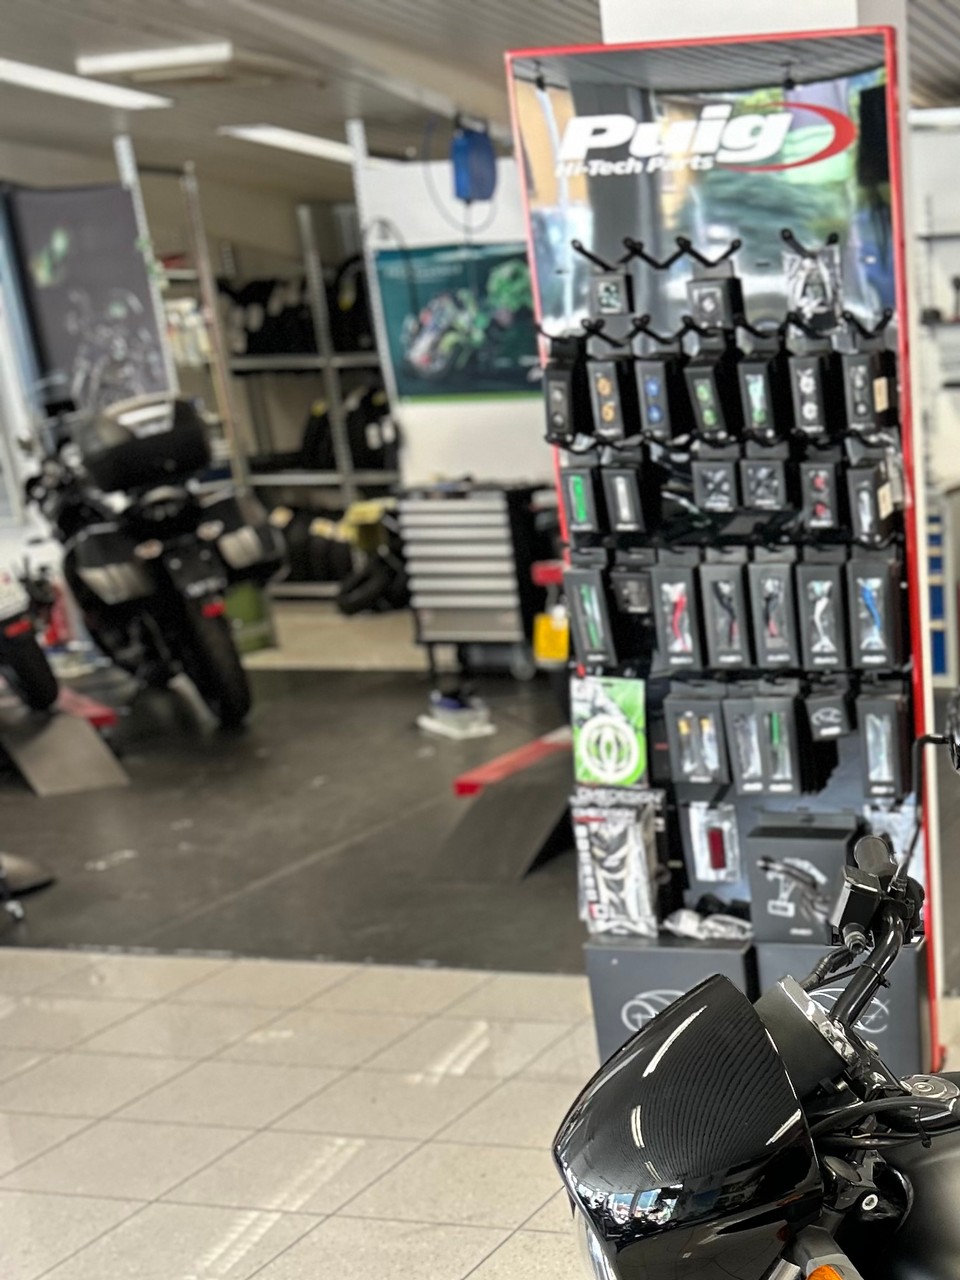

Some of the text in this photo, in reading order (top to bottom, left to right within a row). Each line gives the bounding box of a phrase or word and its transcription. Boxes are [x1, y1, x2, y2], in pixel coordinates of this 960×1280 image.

[556, 103, 793, 163] Puig
[555, 155, 714, 177] Hi-Tech Parts
